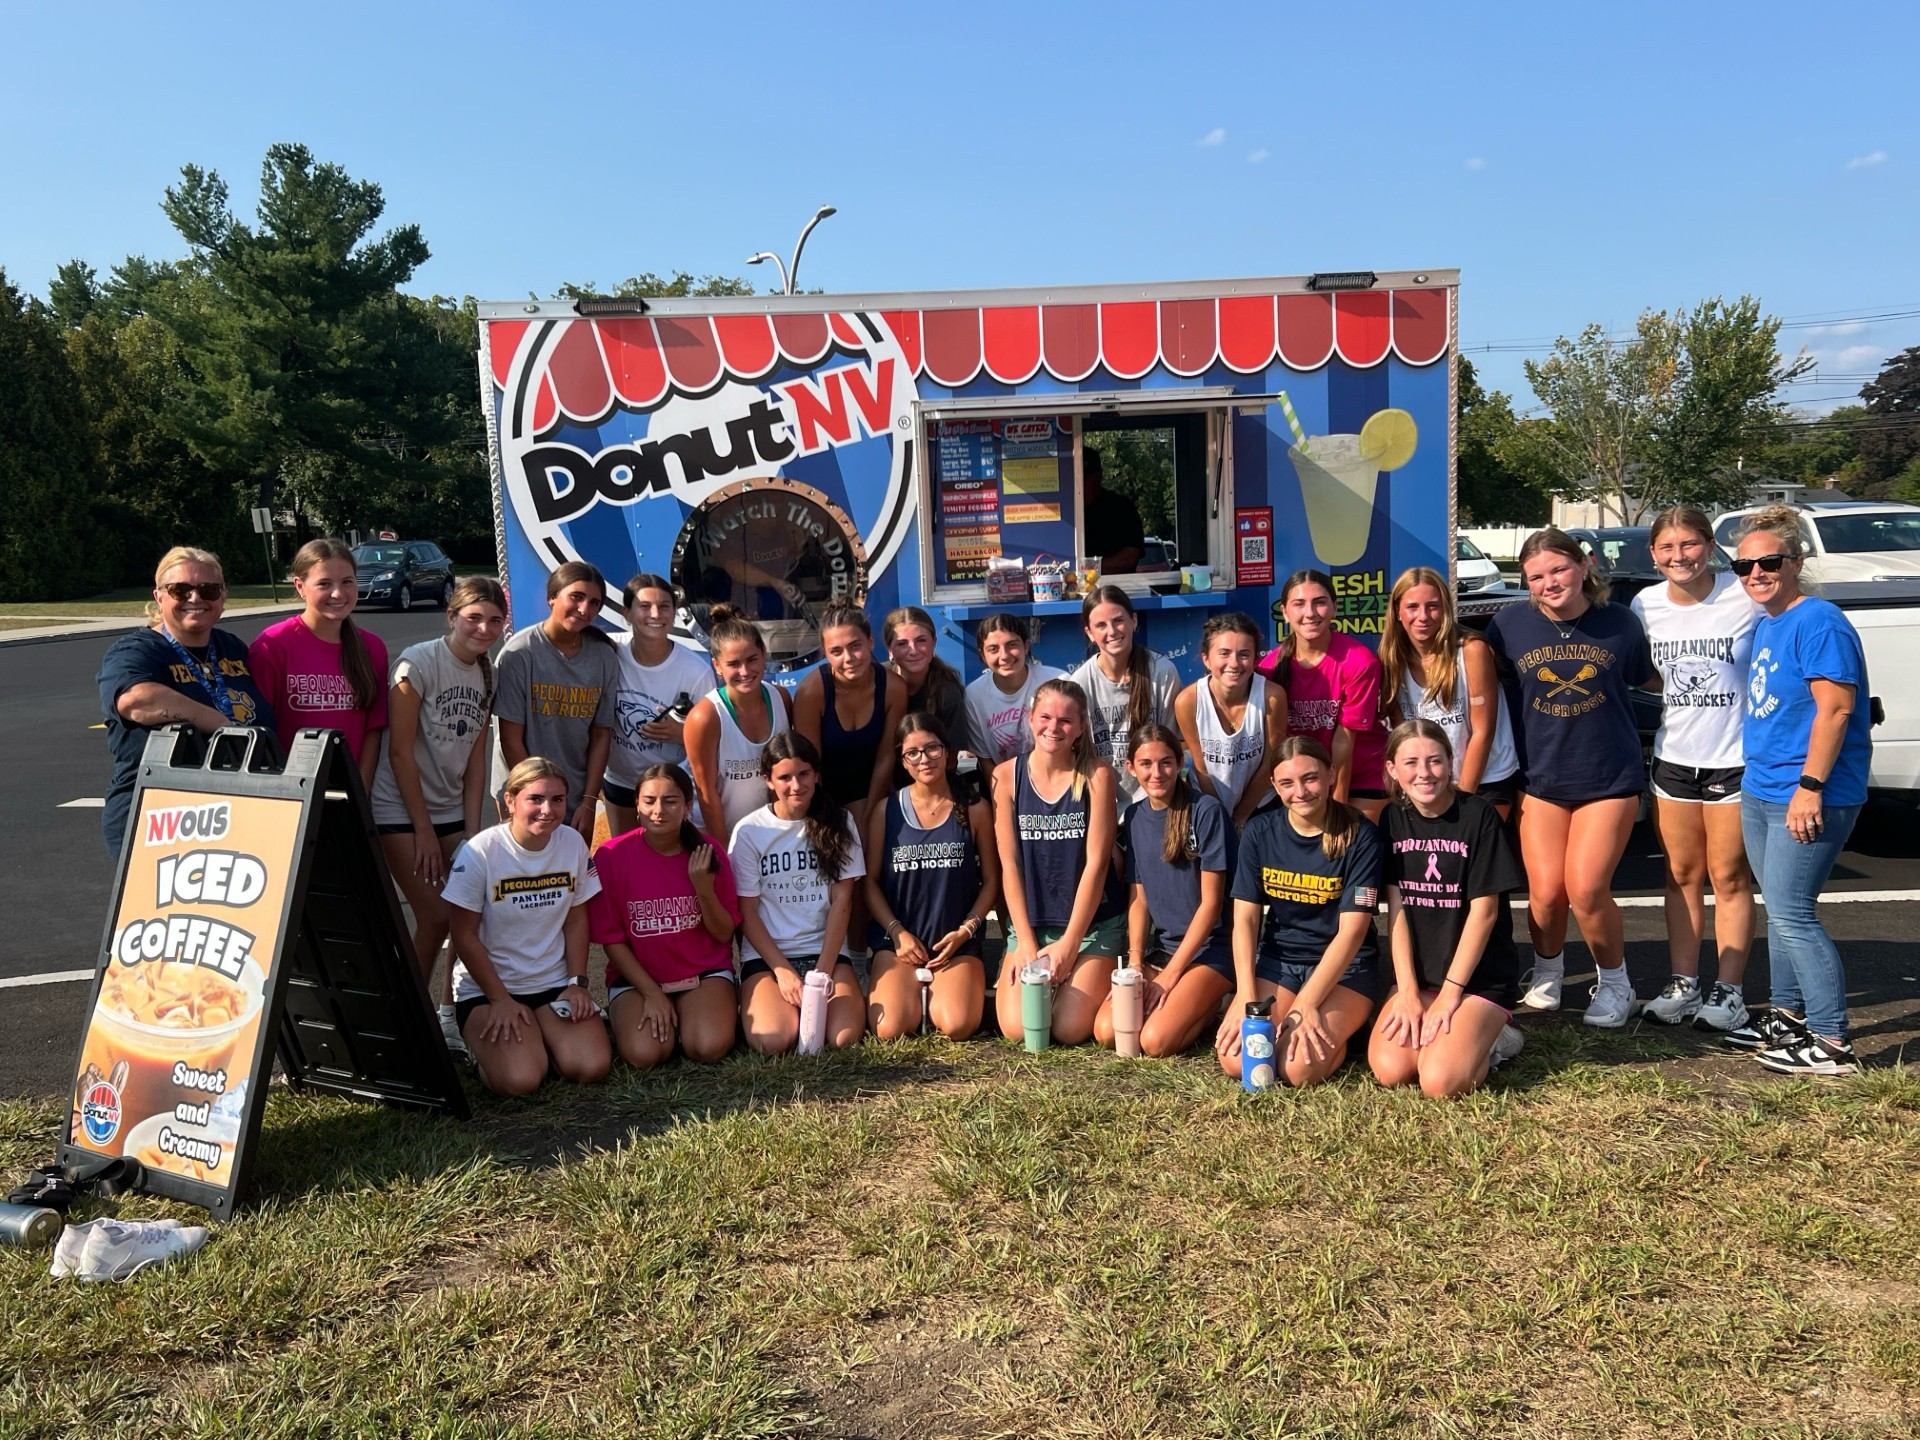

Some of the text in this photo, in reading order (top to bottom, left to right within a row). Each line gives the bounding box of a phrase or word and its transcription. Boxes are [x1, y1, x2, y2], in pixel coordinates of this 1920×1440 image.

[520, 357, 896, 523] DonutNV
[787, 501, 824, 538] The
[956, 559, 989, 568] GLAZE
[1331, 570, 1384, 596] ESH
[1518, 643, 1616, 674] PEQUANNOCK
[1652, 636, 1735, 667] PEQUANNOCK
[301, 694, 336, 705] FIELD
[1532, 691, 1608, 718] LACROSSE
[1692, 691, 1736, 708] HOCKEY
[1754, 693, 1780, 720] PRIDE
[725, 771, 753, 780] FIELD
[147, 805, 229, 843] NVOUS
[1043, 828, 1086, 841] HOCKEY
[892, 842, 965, 863] PEQUANNOCK
[761, 851, 790, 877] ERO
[893, 858, 964, 873] FIELD HOCKEY
[157, 849, 268, 909] ICED
[504, 875, 569, 892] PEQUANNOCK
[767, 882, 790, 890] STAY
[1262, 867, 1343, 892] PEQUANNOCK
[512, 890, 563, 905] PANTHERS
[520, 900, 556, 910] LACROSSE
[779, 893, 823, 904] FLORIDA
[1263, 884, 1328, 906] Lacrosse
[1416, 897, 1435, 908] FOR
[639, 917, 673, 930] FIELD
[119, 914, 257, 982] COFFEE
[172, 1060, 227, 1095] Sweet
[83, 1104, 121, 1123] DonutNV
[174, 1100, 211, 1128] and
[158, 1125, 222, 1171] Creamy
